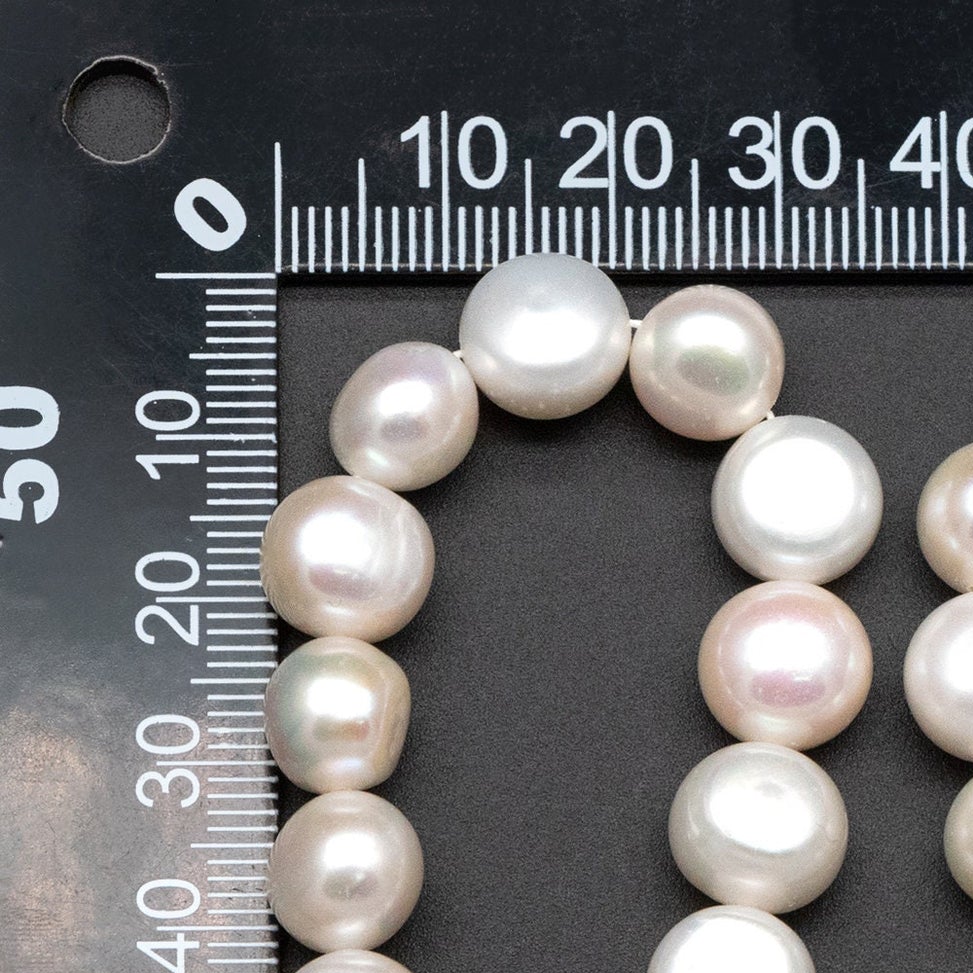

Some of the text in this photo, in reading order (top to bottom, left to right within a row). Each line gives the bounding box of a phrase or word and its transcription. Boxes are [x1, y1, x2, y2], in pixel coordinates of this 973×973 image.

[399, 115, 508, 190] 10
[557, 115, 674, 190] 20
[726, 115, 842, 190] 30
[173, 177, 247, 252] 0
[0, 385, 60, 524] 50
[134, 389, 201, 481] 10
[134, 551, 201, 645] 20
[134, 713, 201, 808] 30
